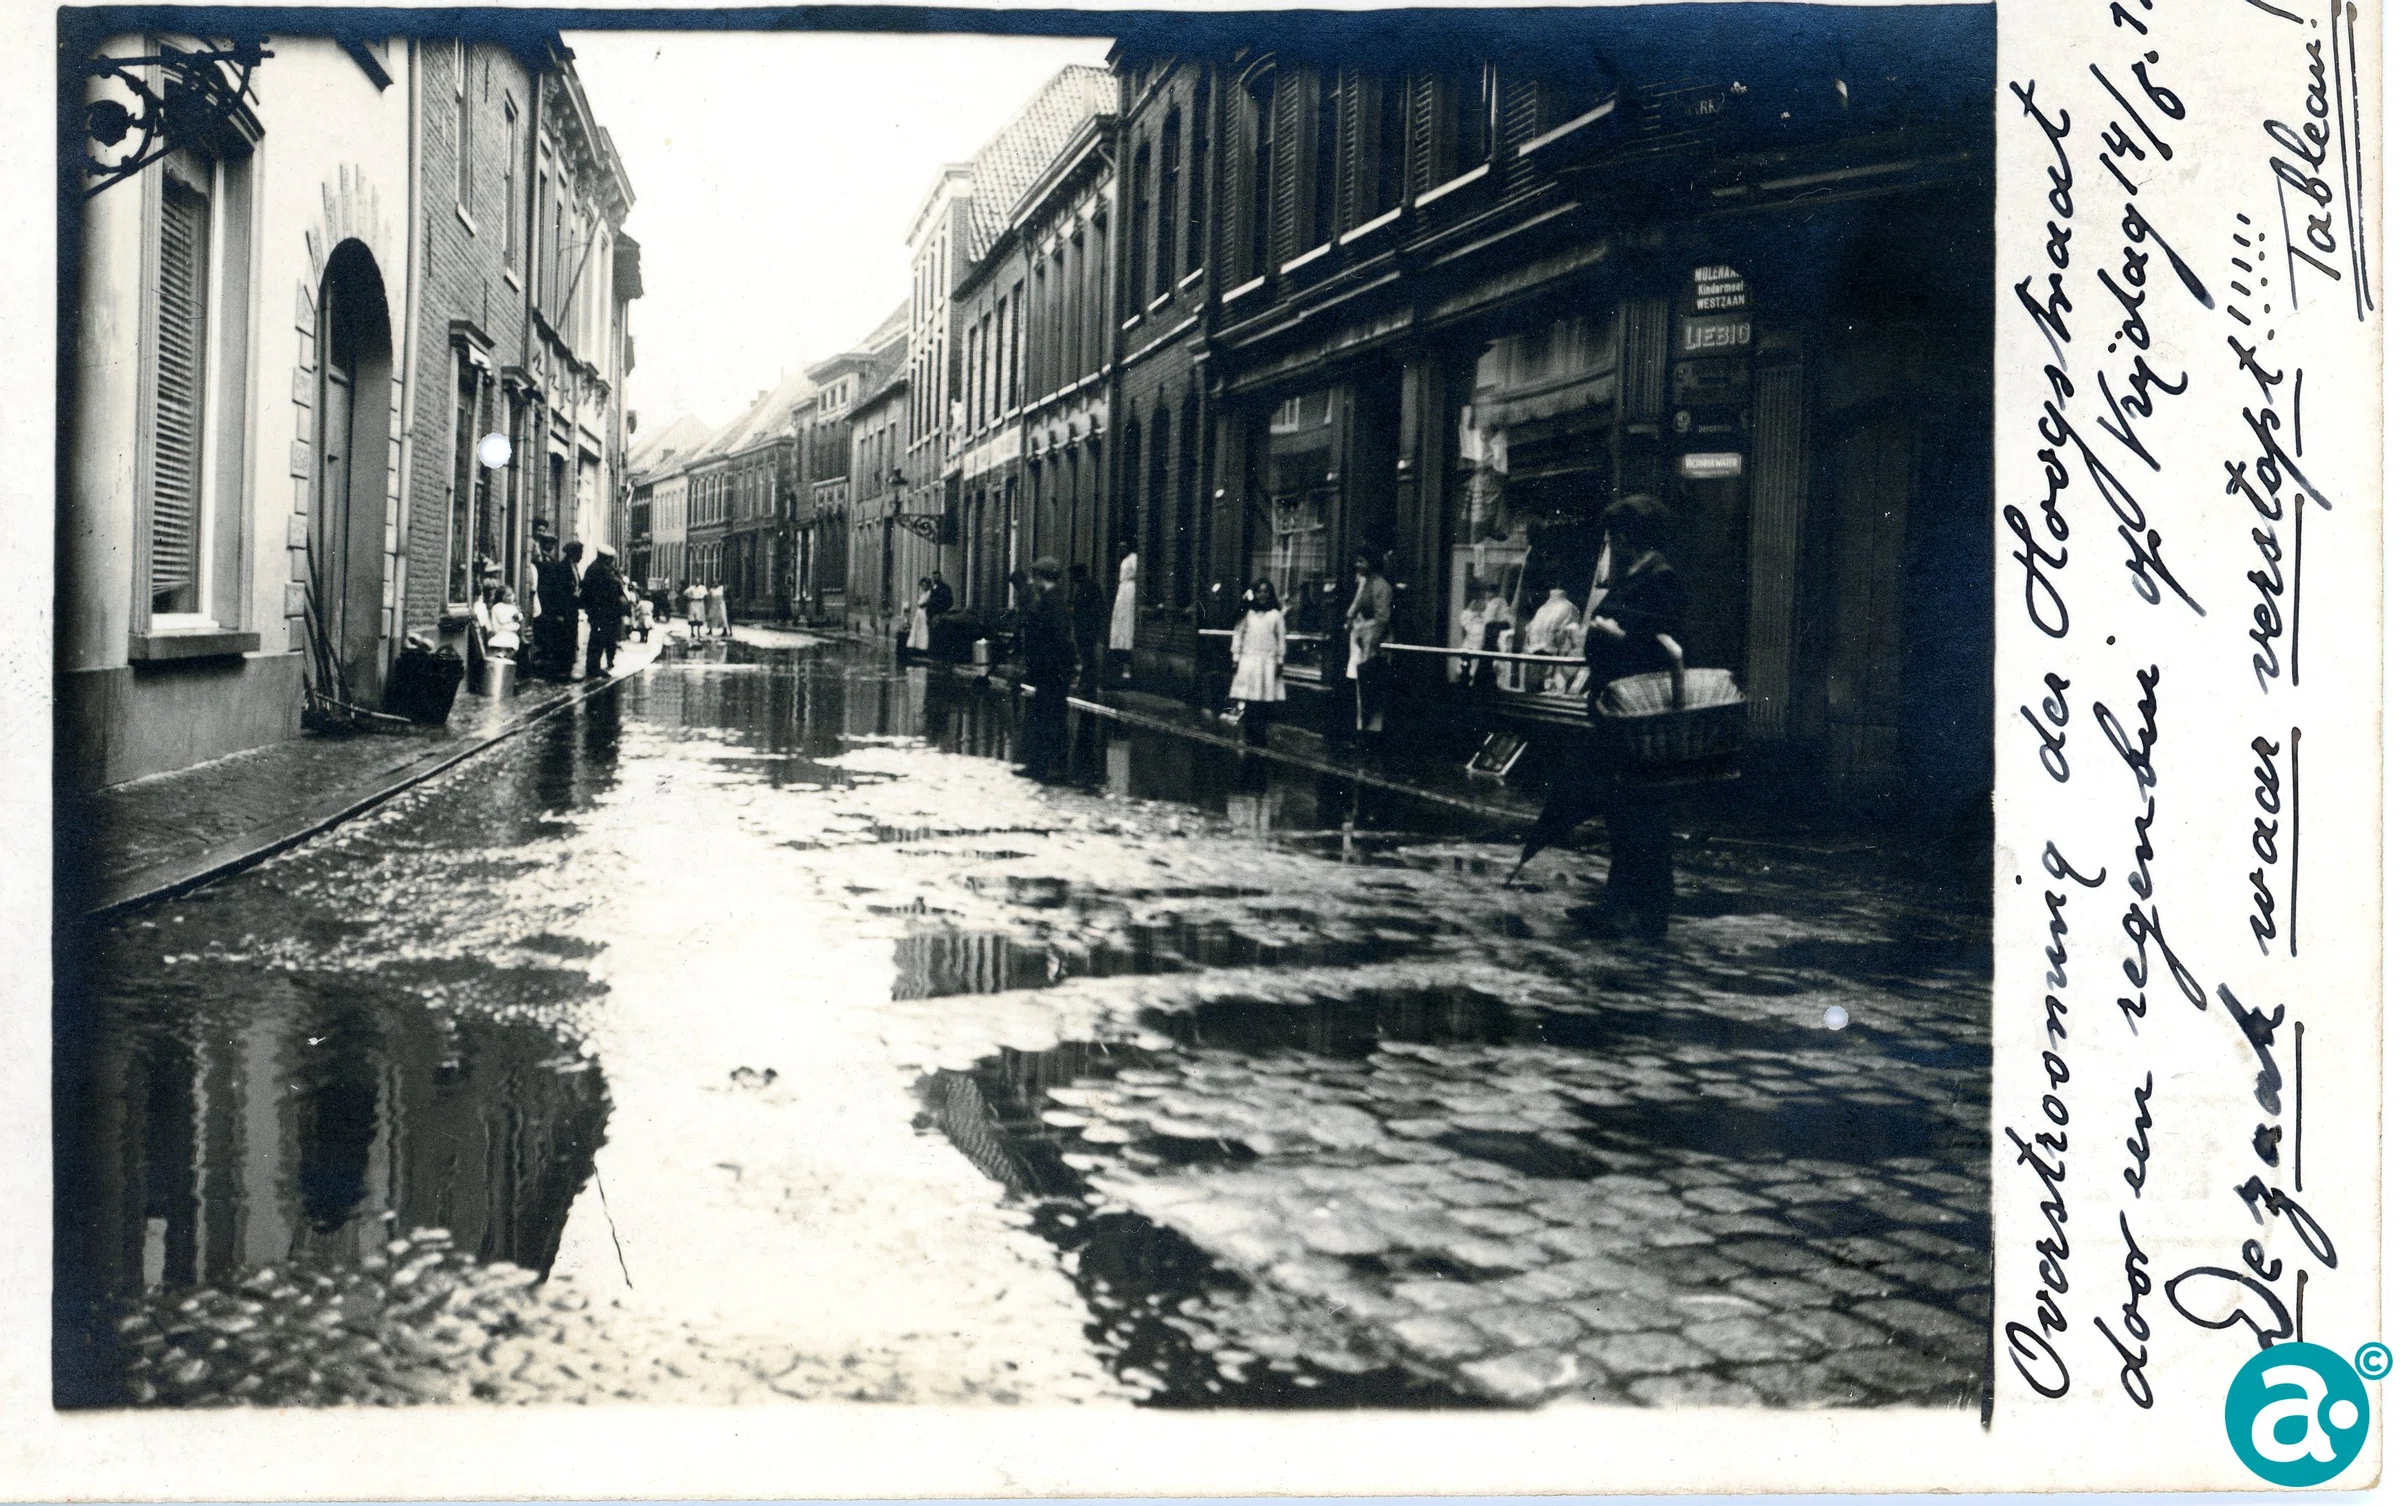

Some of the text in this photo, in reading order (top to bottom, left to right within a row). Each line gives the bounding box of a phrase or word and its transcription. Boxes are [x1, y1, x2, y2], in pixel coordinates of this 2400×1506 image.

[1694, 265, 1743, 283] MOLENAA
[1696, 294, 1745, 310] WESTZAAN
[1685, 322, 1751, 351] LIEBIG
[2003, 80, 2146, 638] Hoogstraat
[2118, 525, 2204, 616] op
[2021, 673, 2070, 786] der
[2124, 1071, 2152, 1198] een
[2094, 1211, 2153, 1409] door
